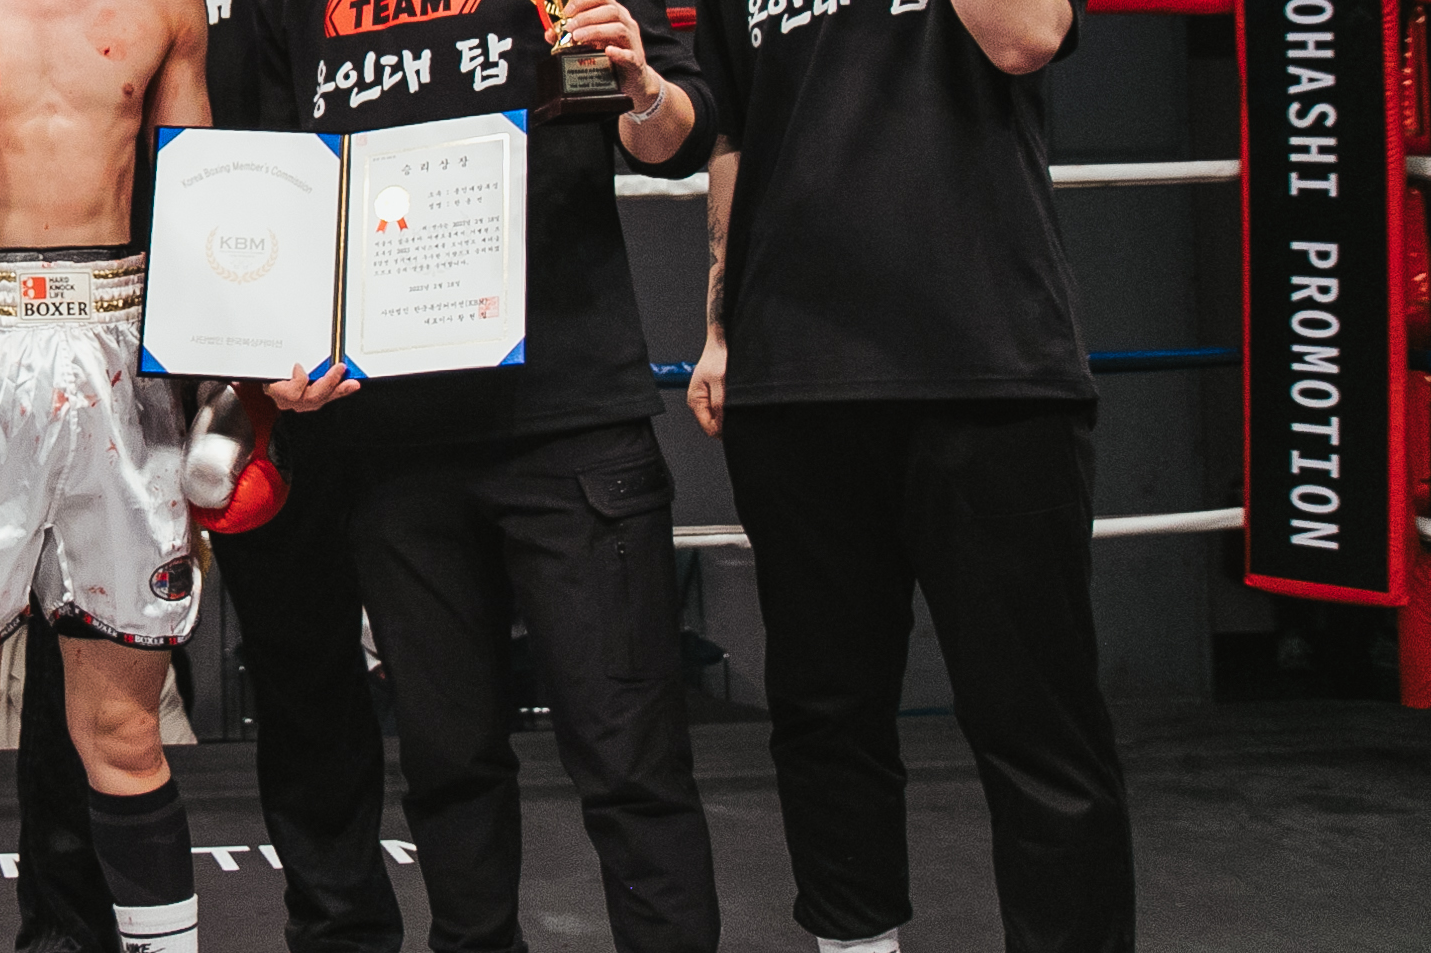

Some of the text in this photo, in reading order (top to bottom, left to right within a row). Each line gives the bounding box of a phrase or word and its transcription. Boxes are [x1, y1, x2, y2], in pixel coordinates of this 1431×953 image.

[313, 49, 432, 119] 용인대
[455, 33, 513, 92] 탑
[181, 172, 204, 189] Korea
[203, 163, 231, 178] Boxing
[271, 165, 313, 194] Commission
[219, 236, 265, 251] KBM
[49, 276, 70, 284] HARD
[49, 291, 65, 299] LIFE
[24, 302, 88, 317] BOXER
[1289, 241, 1341, 550] PROMOTION
